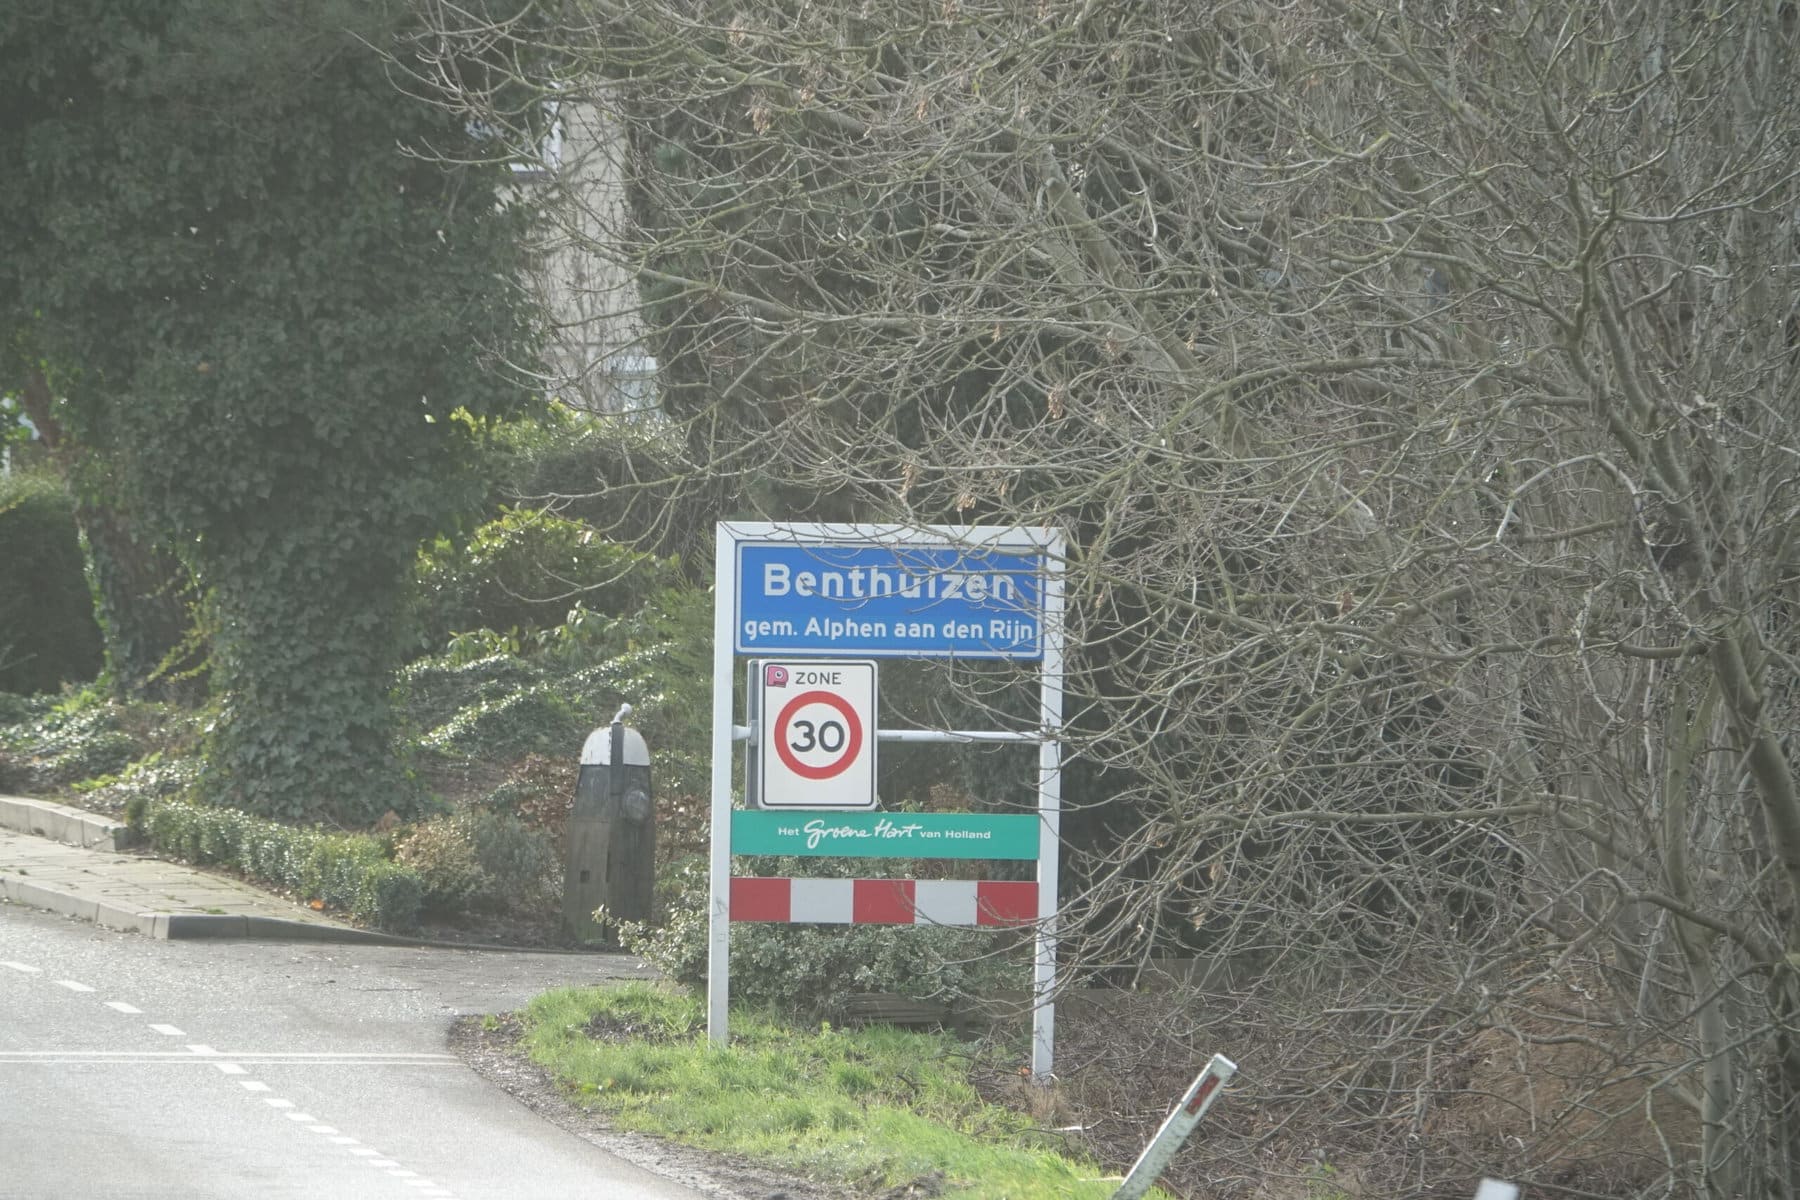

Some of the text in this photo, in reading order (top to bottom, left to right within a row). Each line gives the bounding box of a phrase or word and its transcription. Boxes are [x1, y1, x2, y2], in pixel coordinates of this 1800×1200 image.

[764, 563, 1014, 600] Benthuizen
[744, 617, 1033, 644] gem. Alphen aan den Rijn
[795, 672, 842, 685] ZONE
[791, 720, 845, 753] 30
[778, 818, 991, 849] Het Groene Hart van Holland
